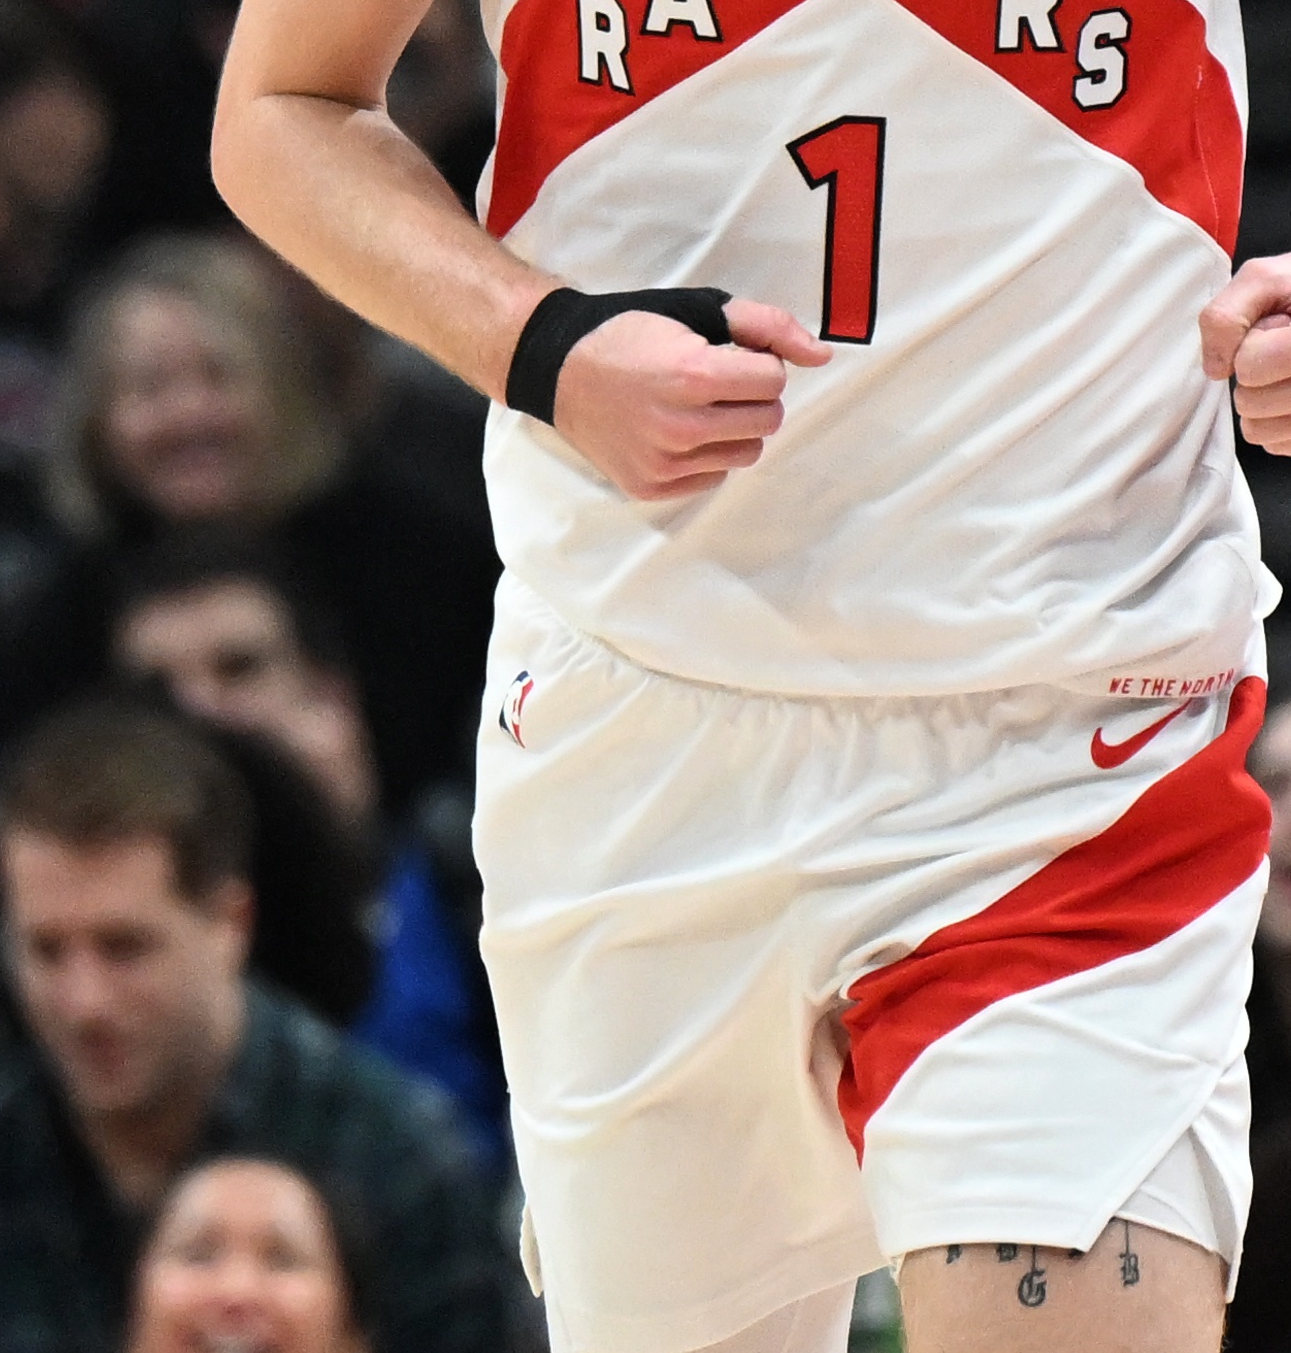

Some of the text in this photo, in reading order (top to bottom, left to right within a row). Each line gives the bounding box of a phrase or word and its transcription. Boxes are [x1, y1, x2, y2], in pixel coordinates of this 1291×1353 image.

[785, 115, 887, 345] 1
[1109, 667, 1235, 696] WE THE NORTH
